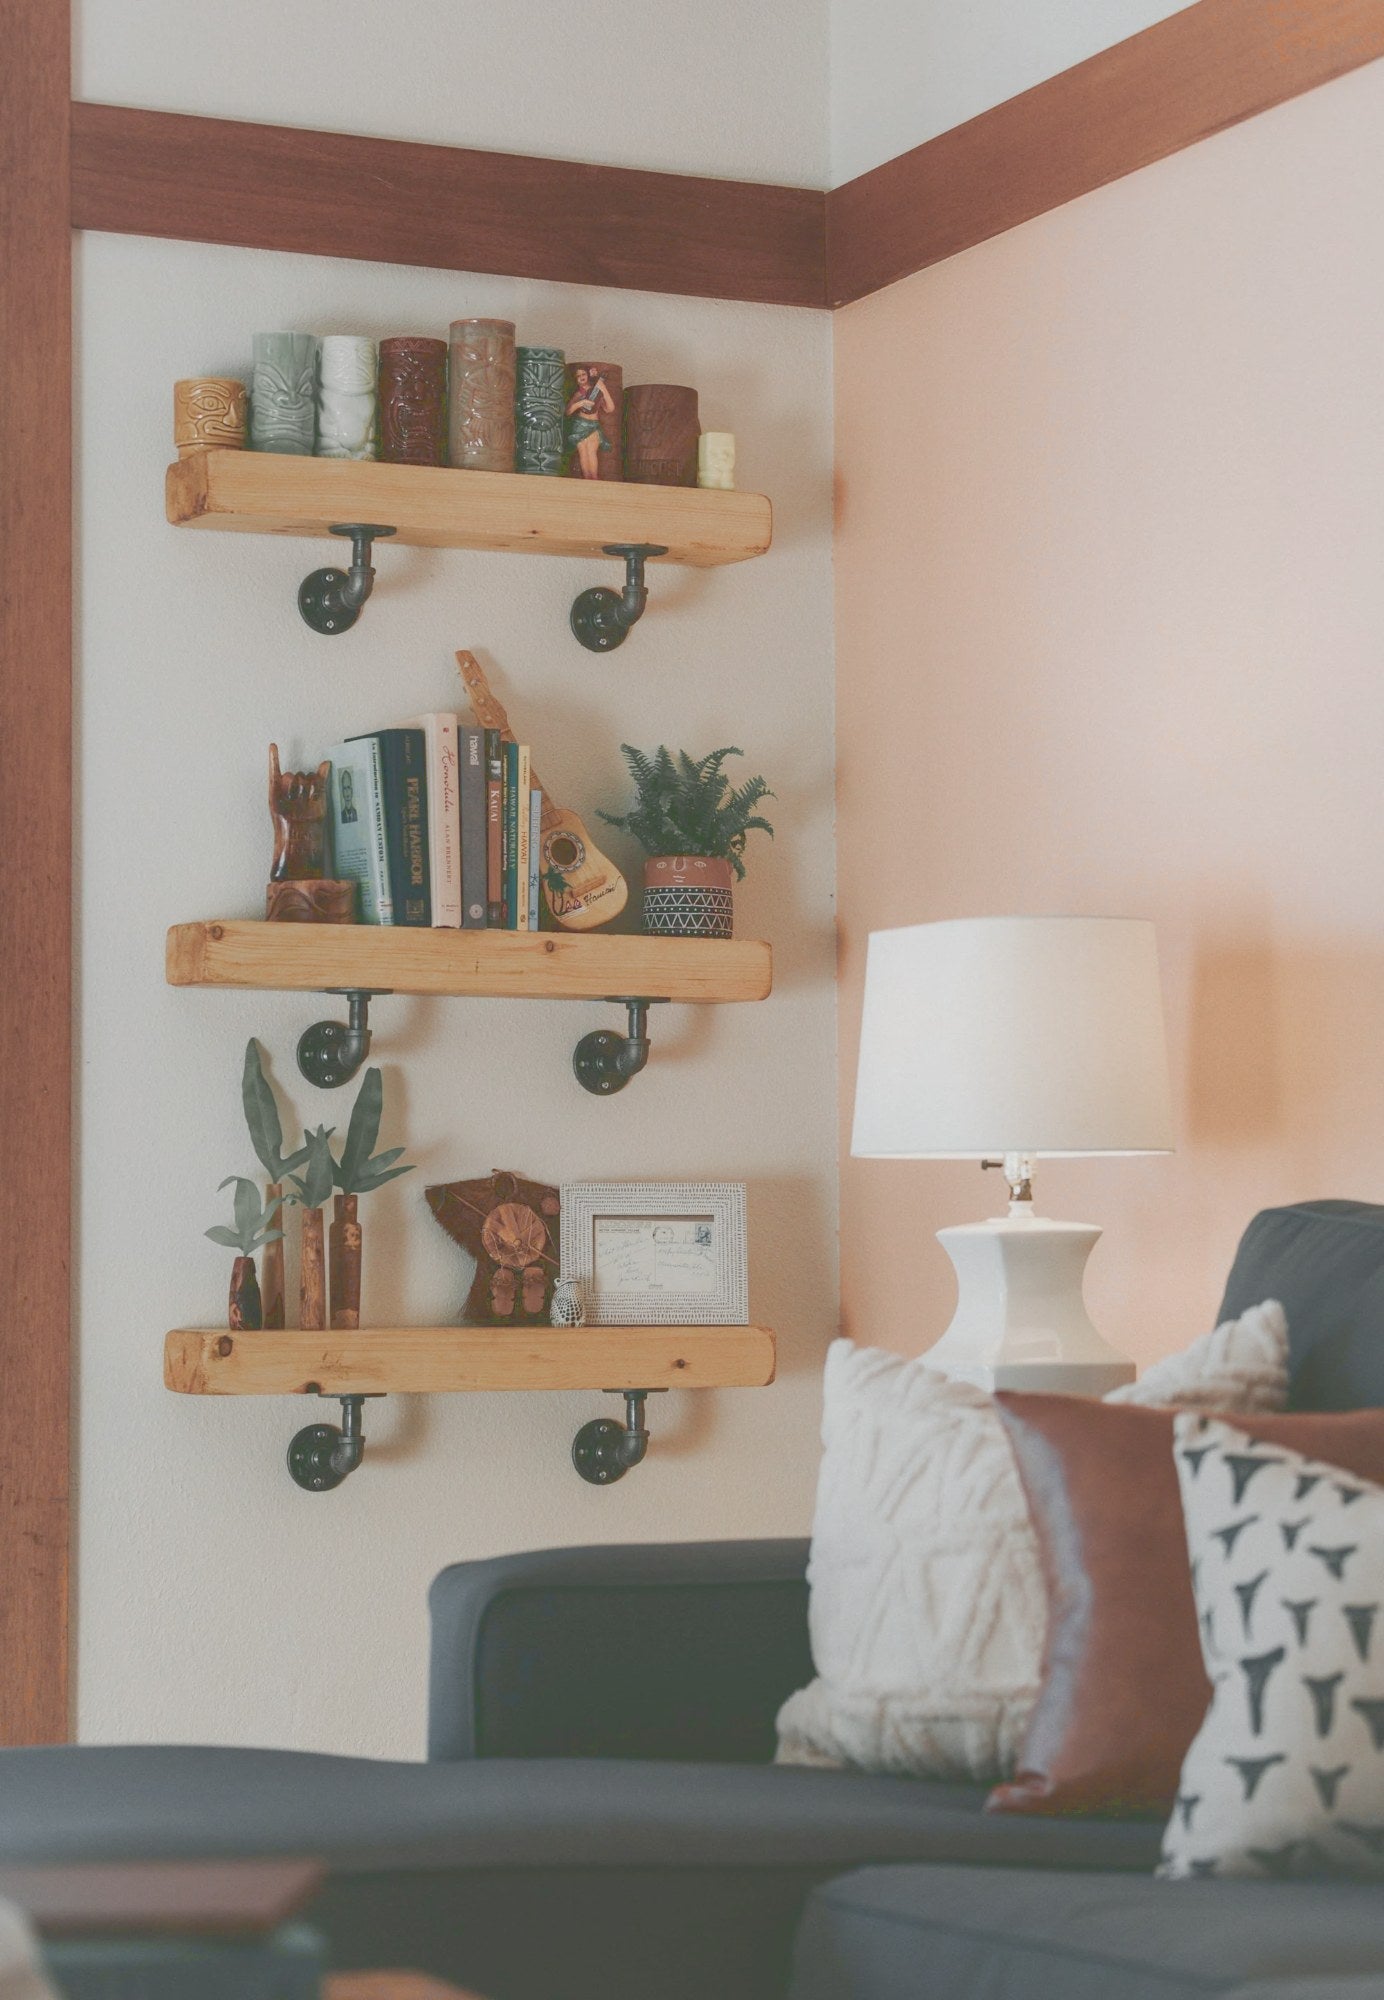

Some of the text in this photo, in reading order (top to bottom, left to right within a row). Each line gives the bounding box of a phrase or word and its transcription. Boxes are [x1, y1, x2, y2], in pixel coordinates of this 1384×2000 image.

[406, 776, 419, 820] PEARL
[442, 745, 456, 813] Honolulu
[490, 790, 500, 823] KAUAI
[409, 824, 423, 886] HARBOR
